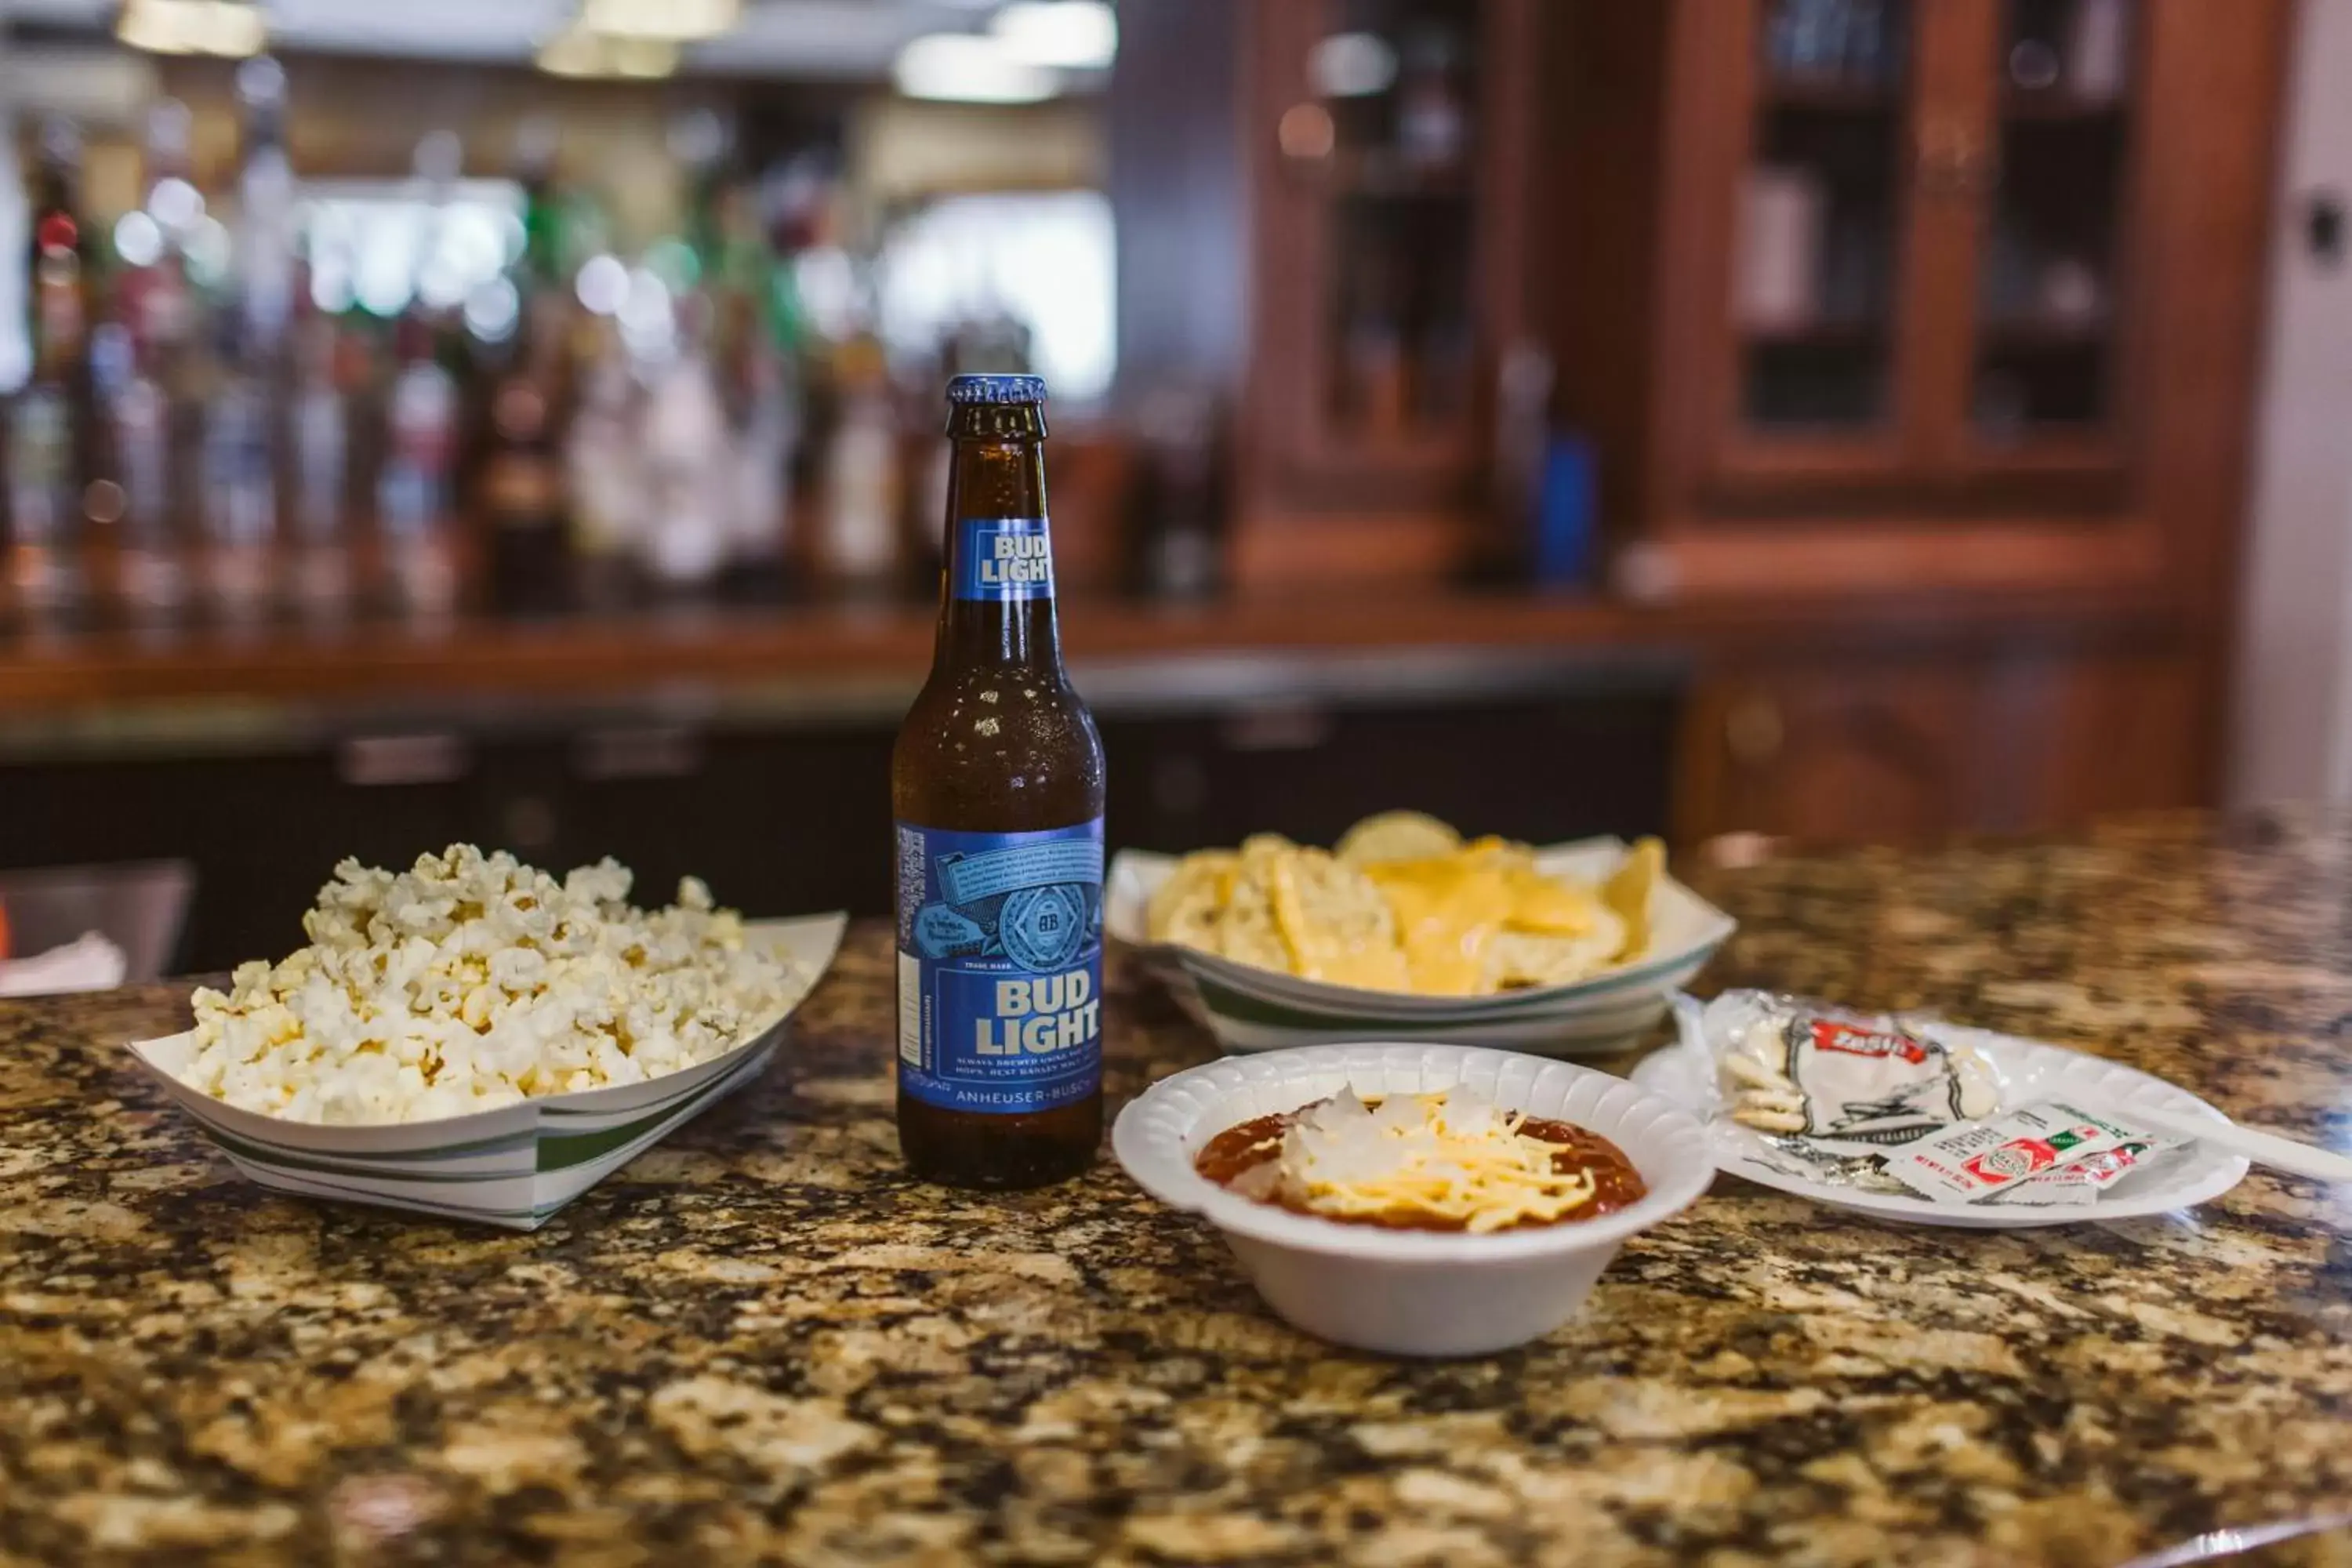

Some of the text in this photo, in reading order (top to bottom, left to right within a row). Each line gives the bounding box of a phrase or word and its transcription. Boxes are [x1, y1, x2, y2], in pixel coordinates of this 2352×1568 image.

[994, 535, 1047, 559] BUD
[996, 969, 1090, 1017] BUD
[976, 998, 1100, 1055] LIGHT
[996, 1058, 1038, 1067] BREWED
